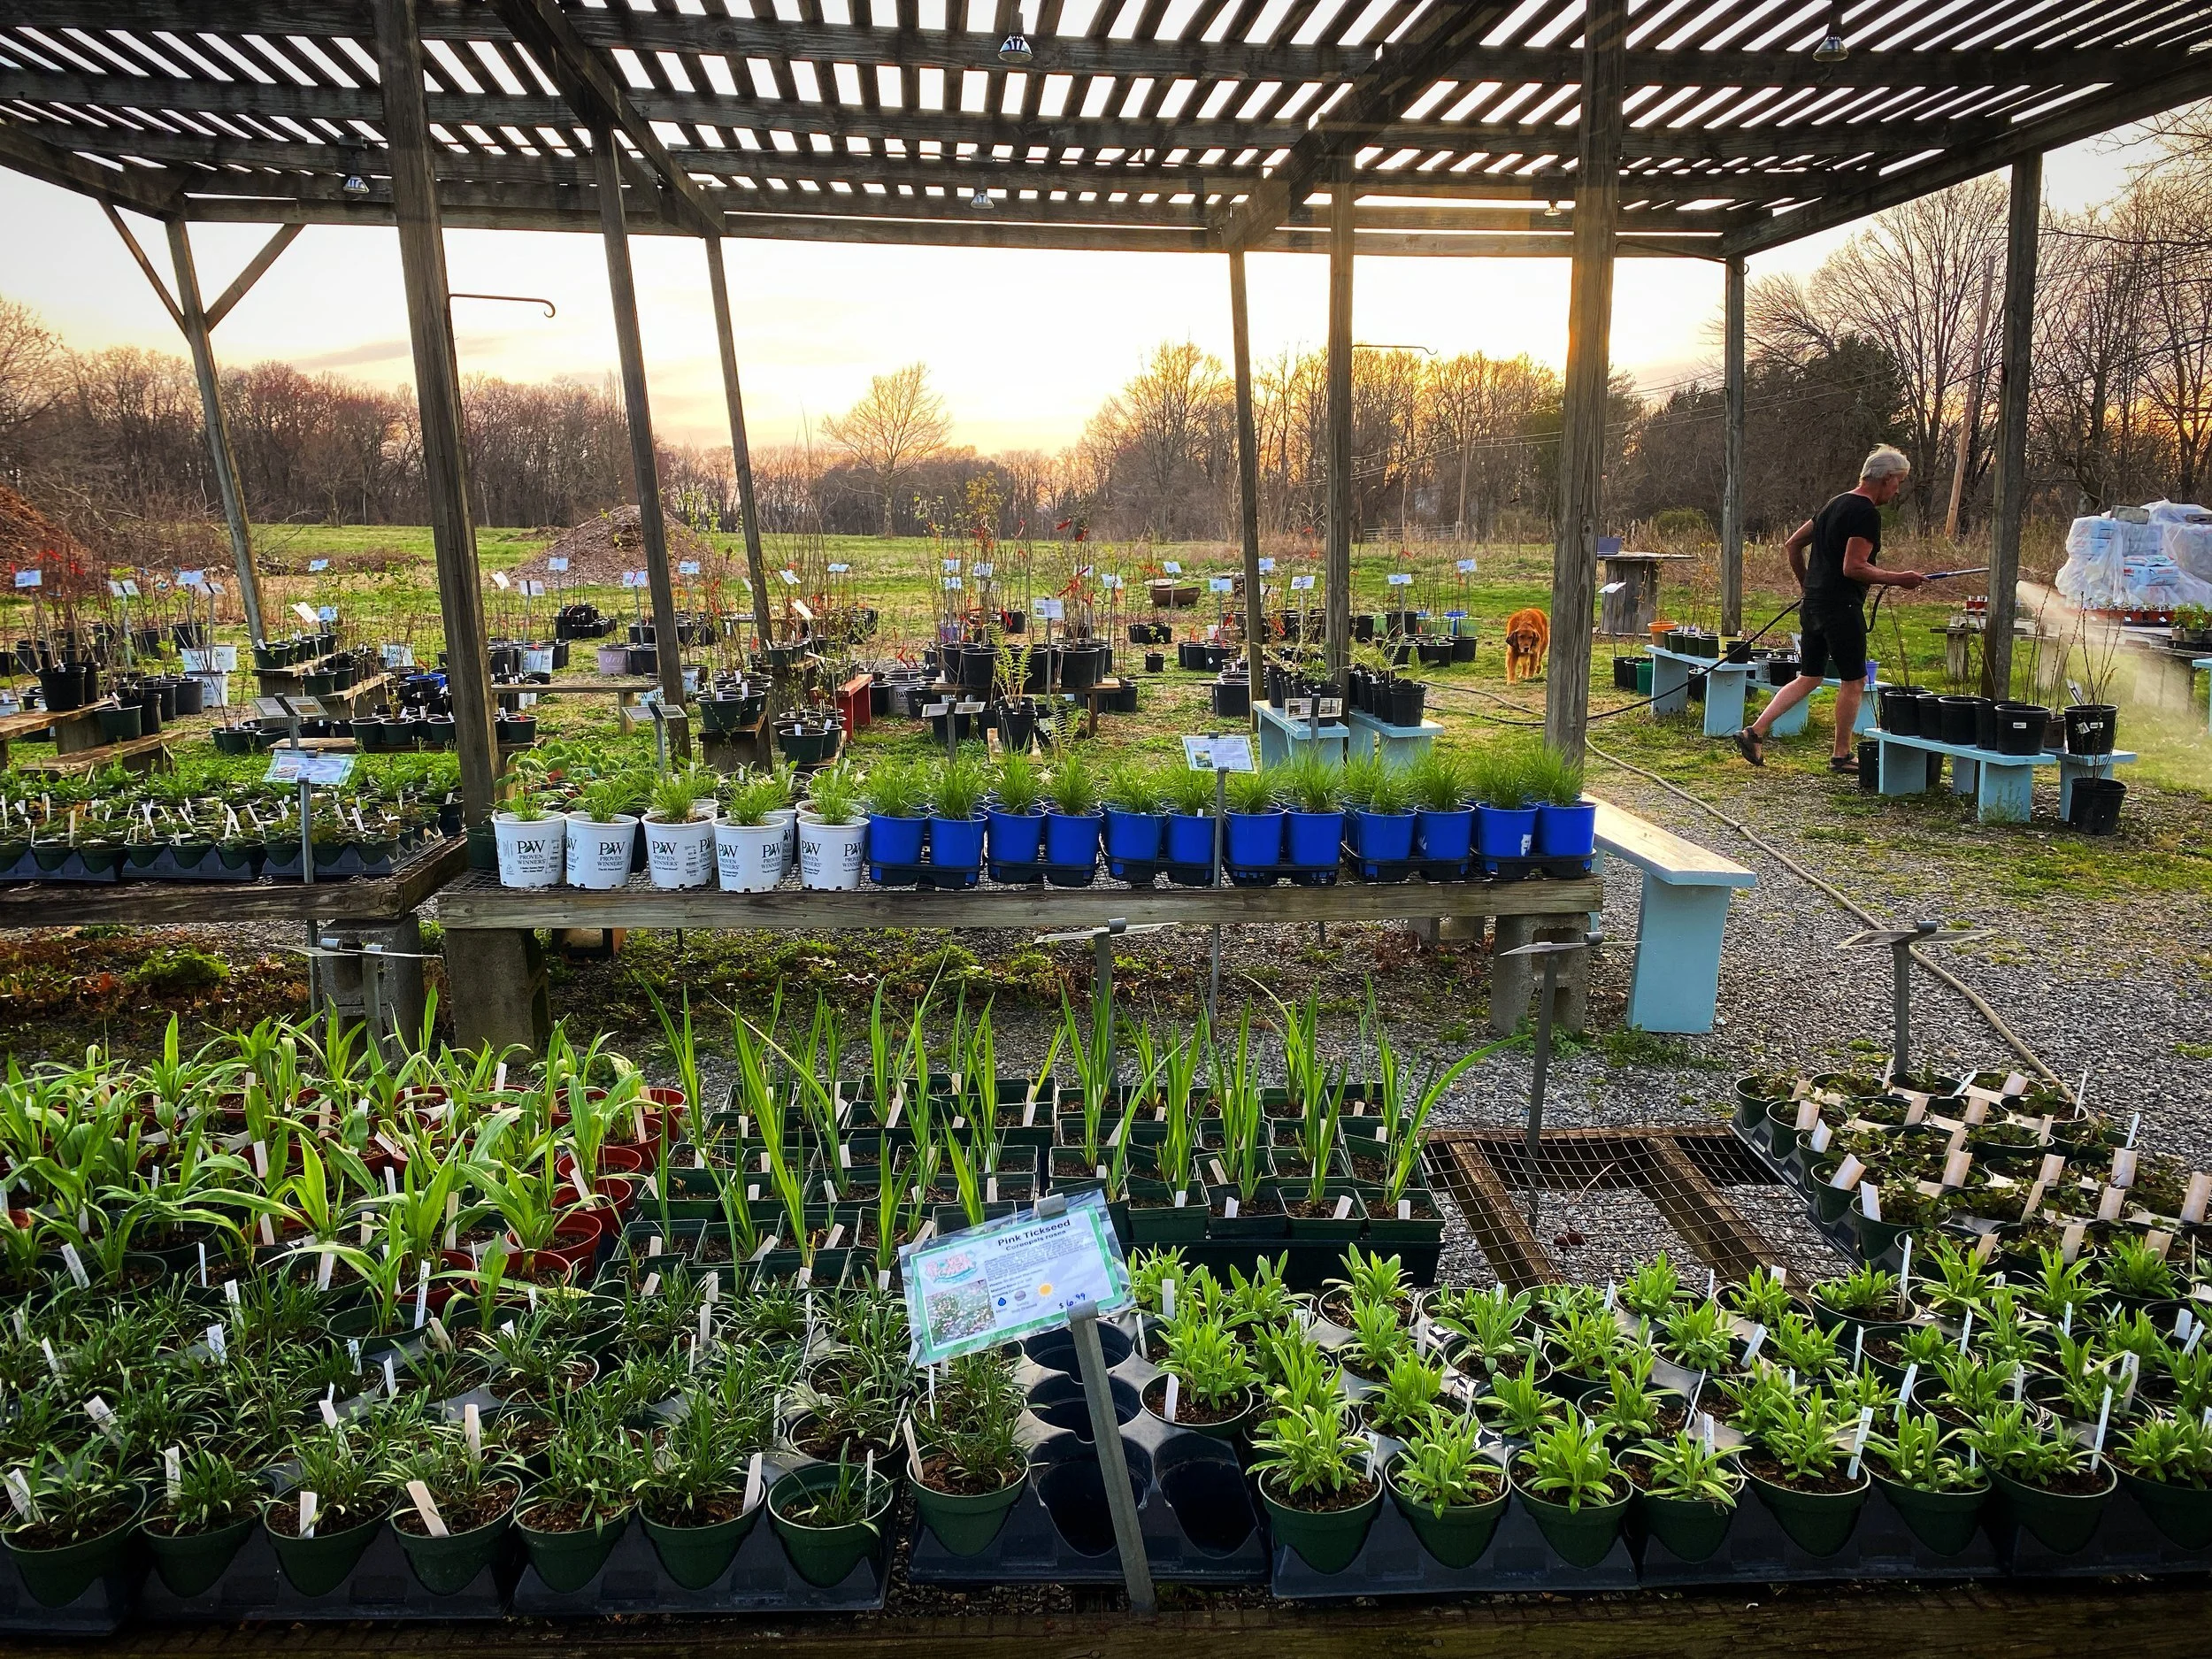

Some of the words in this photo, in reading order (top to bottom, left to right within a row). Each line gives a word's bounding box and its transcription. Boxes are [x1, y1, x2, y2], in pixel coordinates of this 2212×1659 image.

[997, 1234, 1022, 1247] Pink
[1023, 1219, 1071, 1239] Tickseed
[1005, 1236, 1044, 1251] Coreopsis
[1045, 1230, 1066, 1240] rosea
